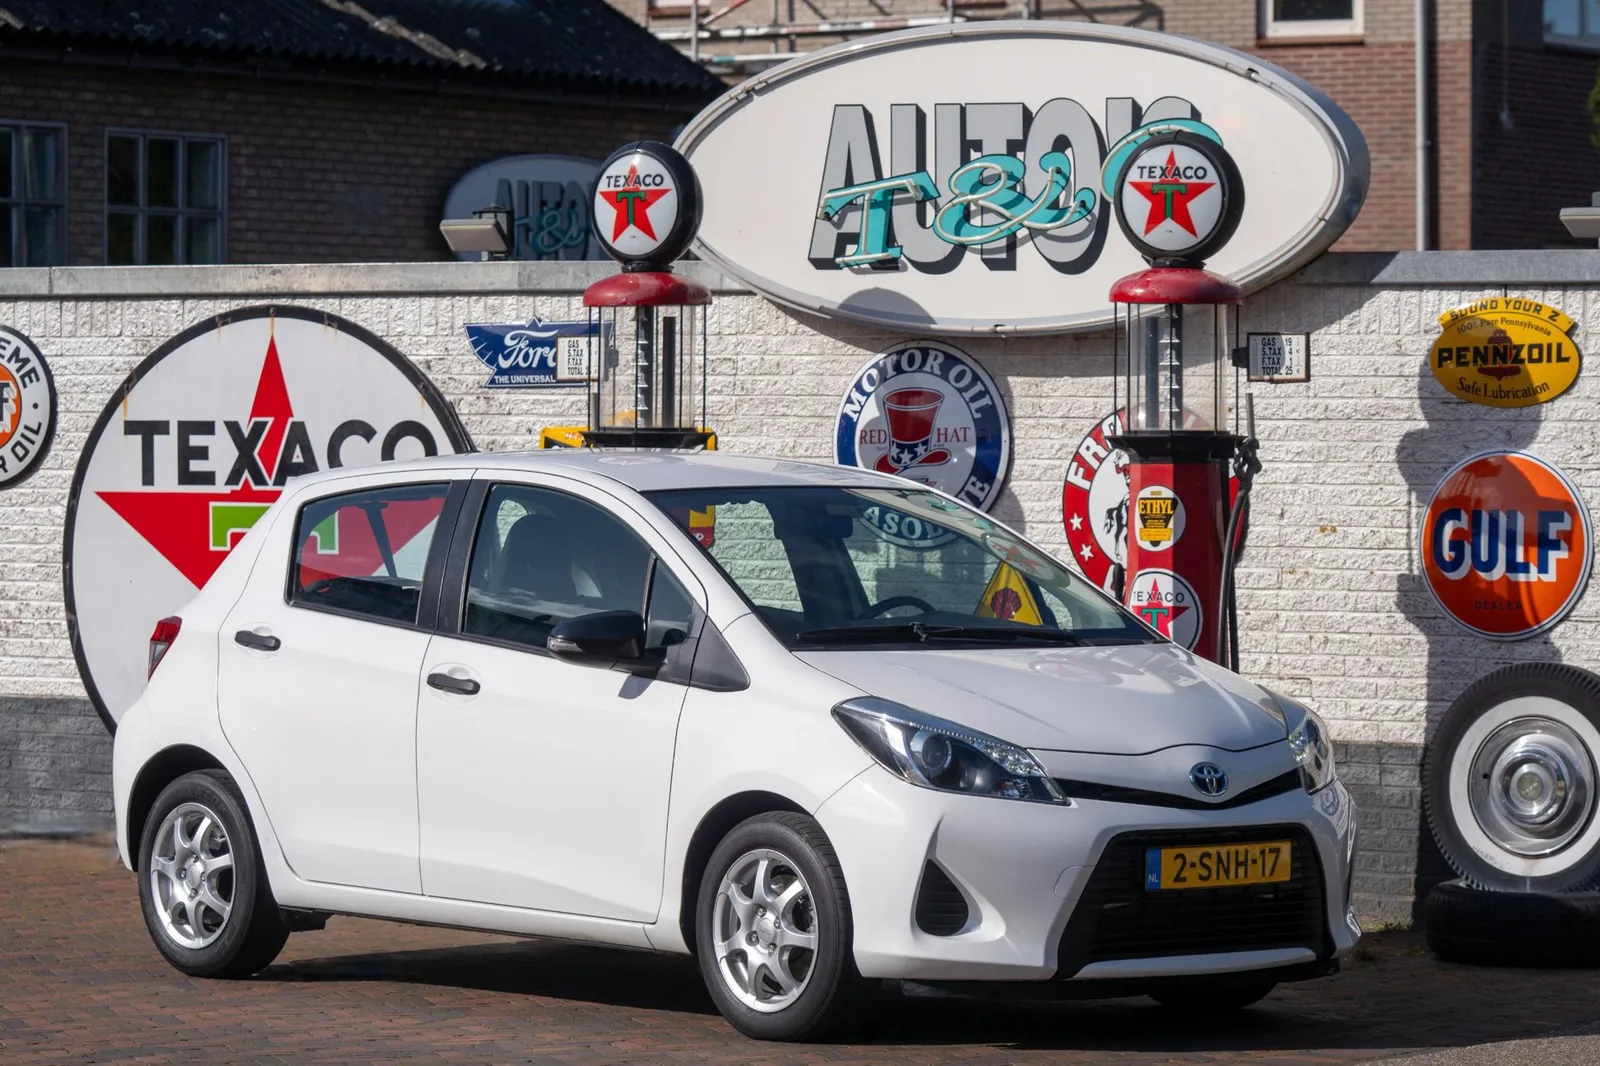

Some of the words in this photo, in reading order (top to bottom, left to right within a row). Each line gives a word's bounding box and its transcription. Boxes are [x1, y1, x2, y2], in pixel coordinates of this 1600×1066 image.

[1137, 166, 1208, 180] TEXACO
[606, 174, 664, 188] TEXACO
[1450, 300, 1498, 322] SOUND
[1505, 299, 1543, 315] YOUR
[1548, 310, 1561, 322] Z
[1480, 318, 1499, 328] Pure
[1501, 317, 1552, 337] Pennsylvania
[567, 340, 579, 349] GAS
[1261, 337, 1276, 346] GAS
[1285, 337, 1293, 346] 19
[567, 349, 583, 358] S.TAX
[1261, 347, 1282, 356] S.TAX
[1438, 342, 1571, 368] PENNZOIL
[1261, 357, 1281, 366] F.TAX
[567, 367, 583, 375] TOTAL
[1261, 366, 1283, 375] TOTAL
[1285, 366, 1293, 375] 25
[494, 375, 510, 384] THE
[511, 374, 557, 384] UNIVERSAL
[842, 348, 945, 422] MOTOR
[948, 364, 993, 419] OIL
[1456, 376, 1482, 396] Safe
[1484, 382, 1550, 399] Lubrication
[11, 422, 42, 463] OIL
[860, 429, 888, 445] RED
[936, 427, 971, 443] HAT
[123, 419, 438, 487] TEXACO
[1138, 499, 1175, 514] ETHYL
[1433, 508, 1572, 582] GULF
[1133, 591, 1185, 603] EXACO
[1474, 600, 1522, 610] DEALER
[1173, 847, 1281, 883] 2-SNH-17
[1148, 873, 1159, 883] NL
